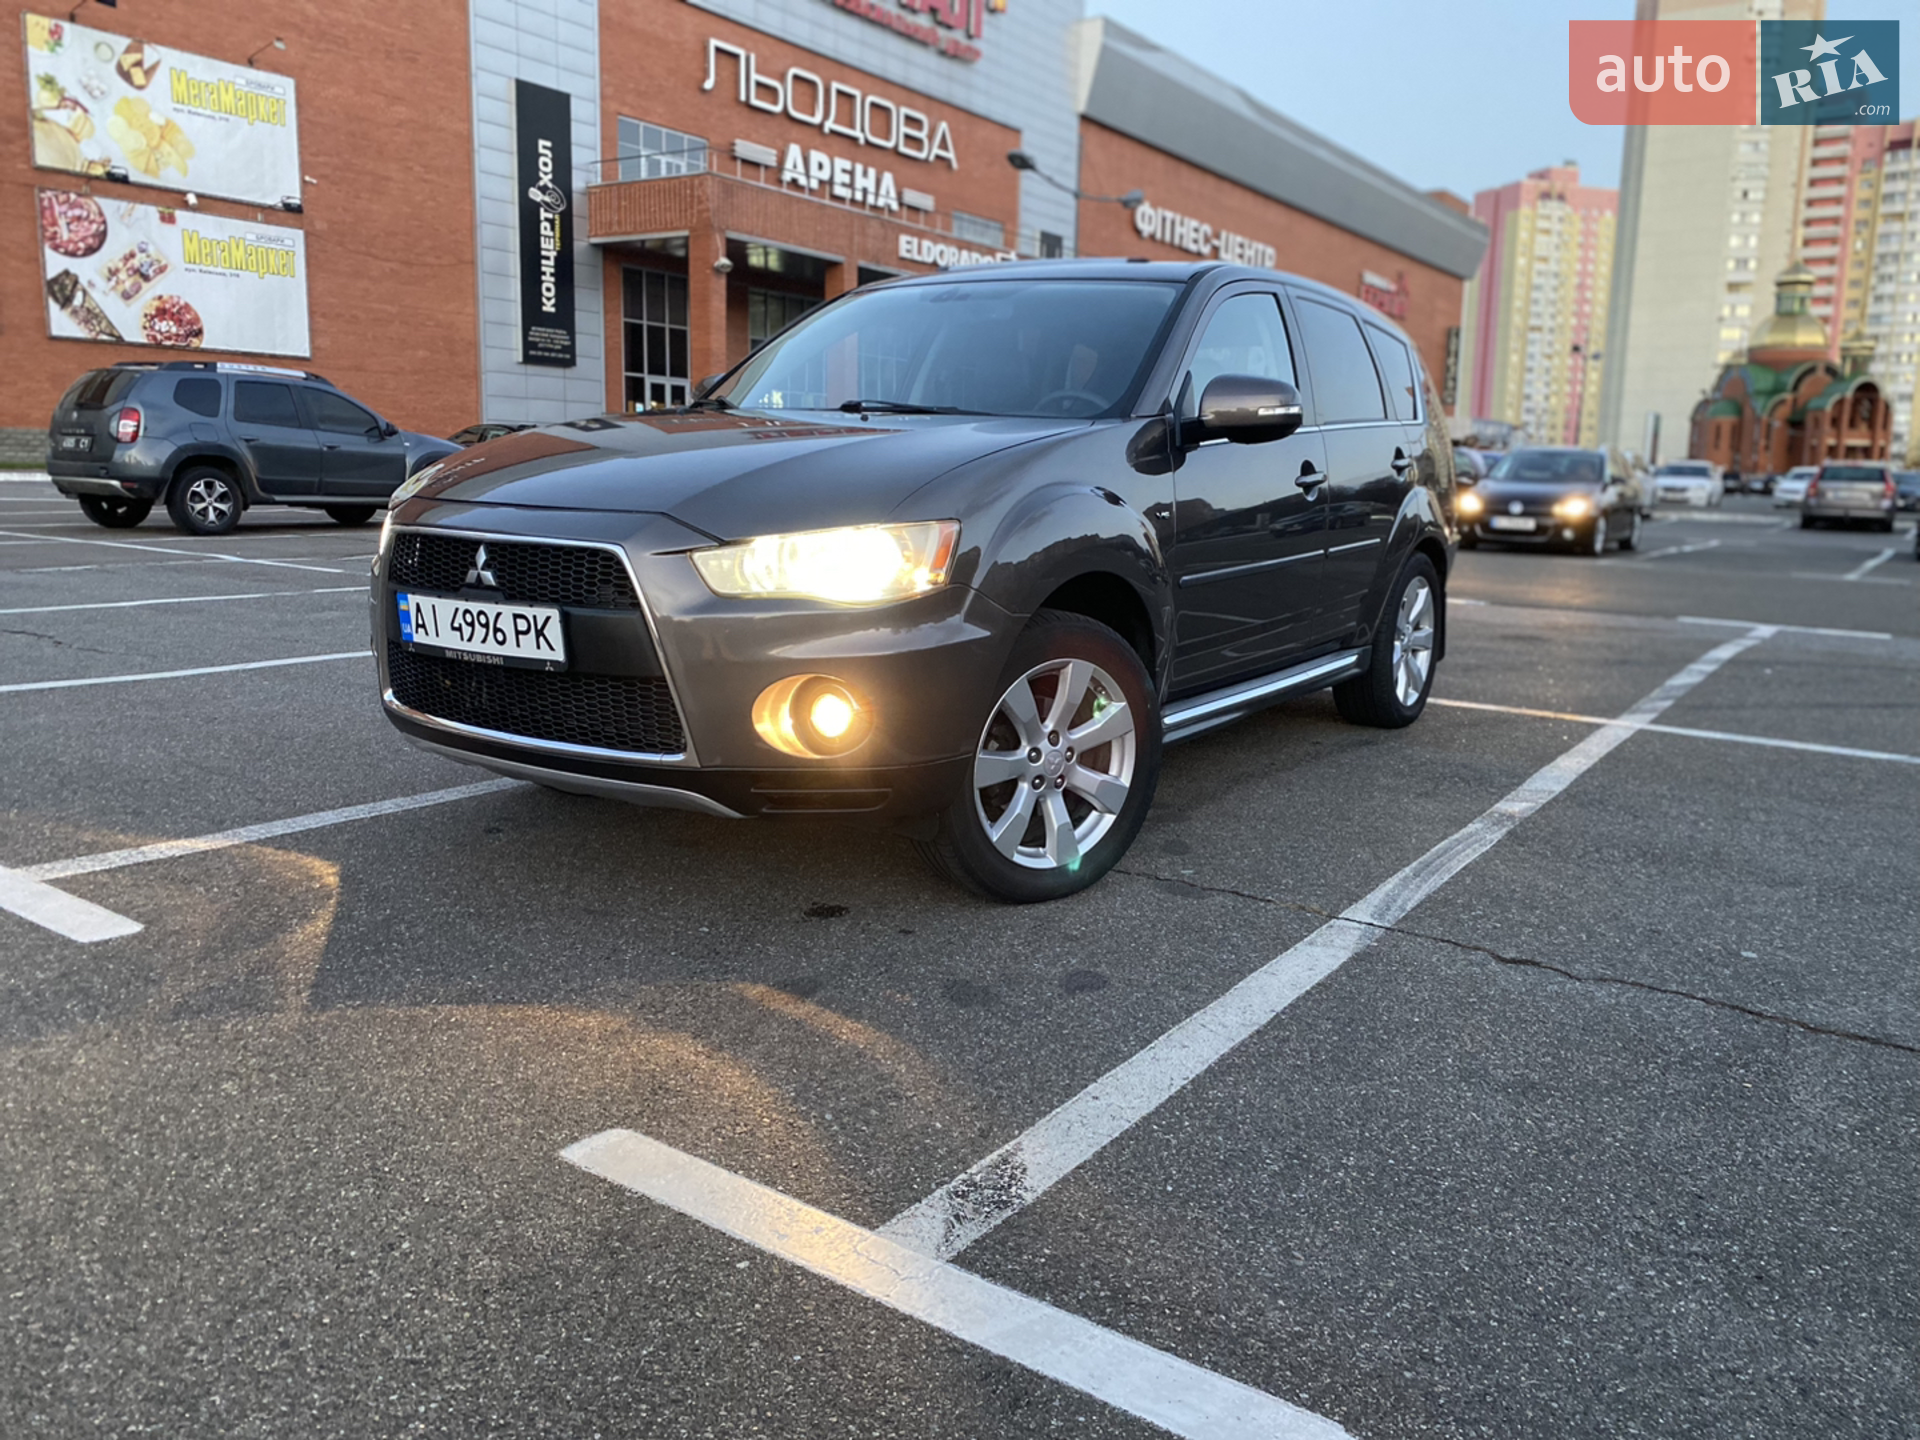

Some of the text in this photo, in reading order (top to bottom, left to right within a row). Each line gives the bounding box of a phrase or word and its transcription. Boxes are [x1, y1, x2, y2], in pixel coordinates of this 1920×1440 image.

[169, 66, 287, 127] МегаМаркет
[701, 37, 959, 171] ЛЬОДОВА
[537, 138, 554, 188] ХОЛ
[781, 142, 900, 212] АРЕНА
[181, 227, 297, 279] МегаМаркет
[539, 207, 558, 313] КОНЦЕРТ
[401, 622, 412, 634] UA
[415, 602, 556, 652] AI 4996 PK
[444, 648, 504, 666] MITSUBISHI
